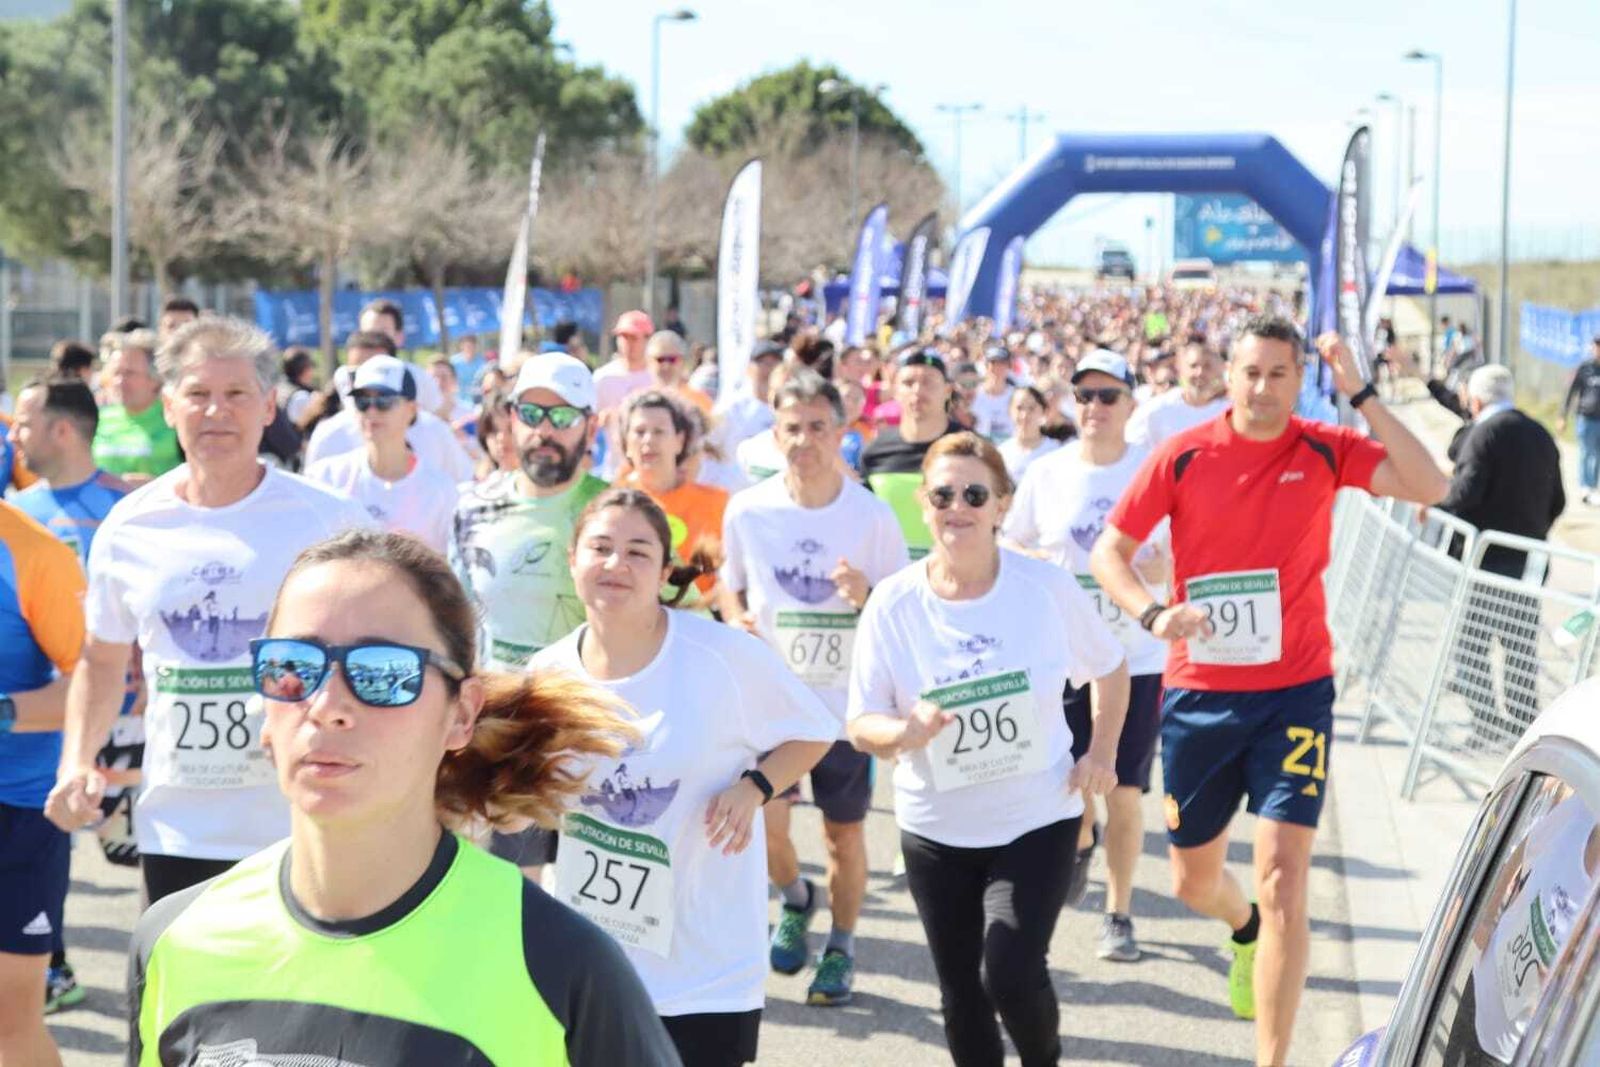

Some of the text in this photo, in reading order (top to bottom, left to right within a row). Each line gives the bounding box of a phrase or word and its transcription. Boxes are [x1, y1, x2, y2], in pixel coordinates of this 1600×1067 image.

[790, 633, 841, 667] 678
[173, 700, 250, 750] 258
[953, 701, 1018, 754] 296
[1282, 726, 1325, 780] 21
[618, 837, 633, 851] DE
[579, 850, 650, 912] 257
